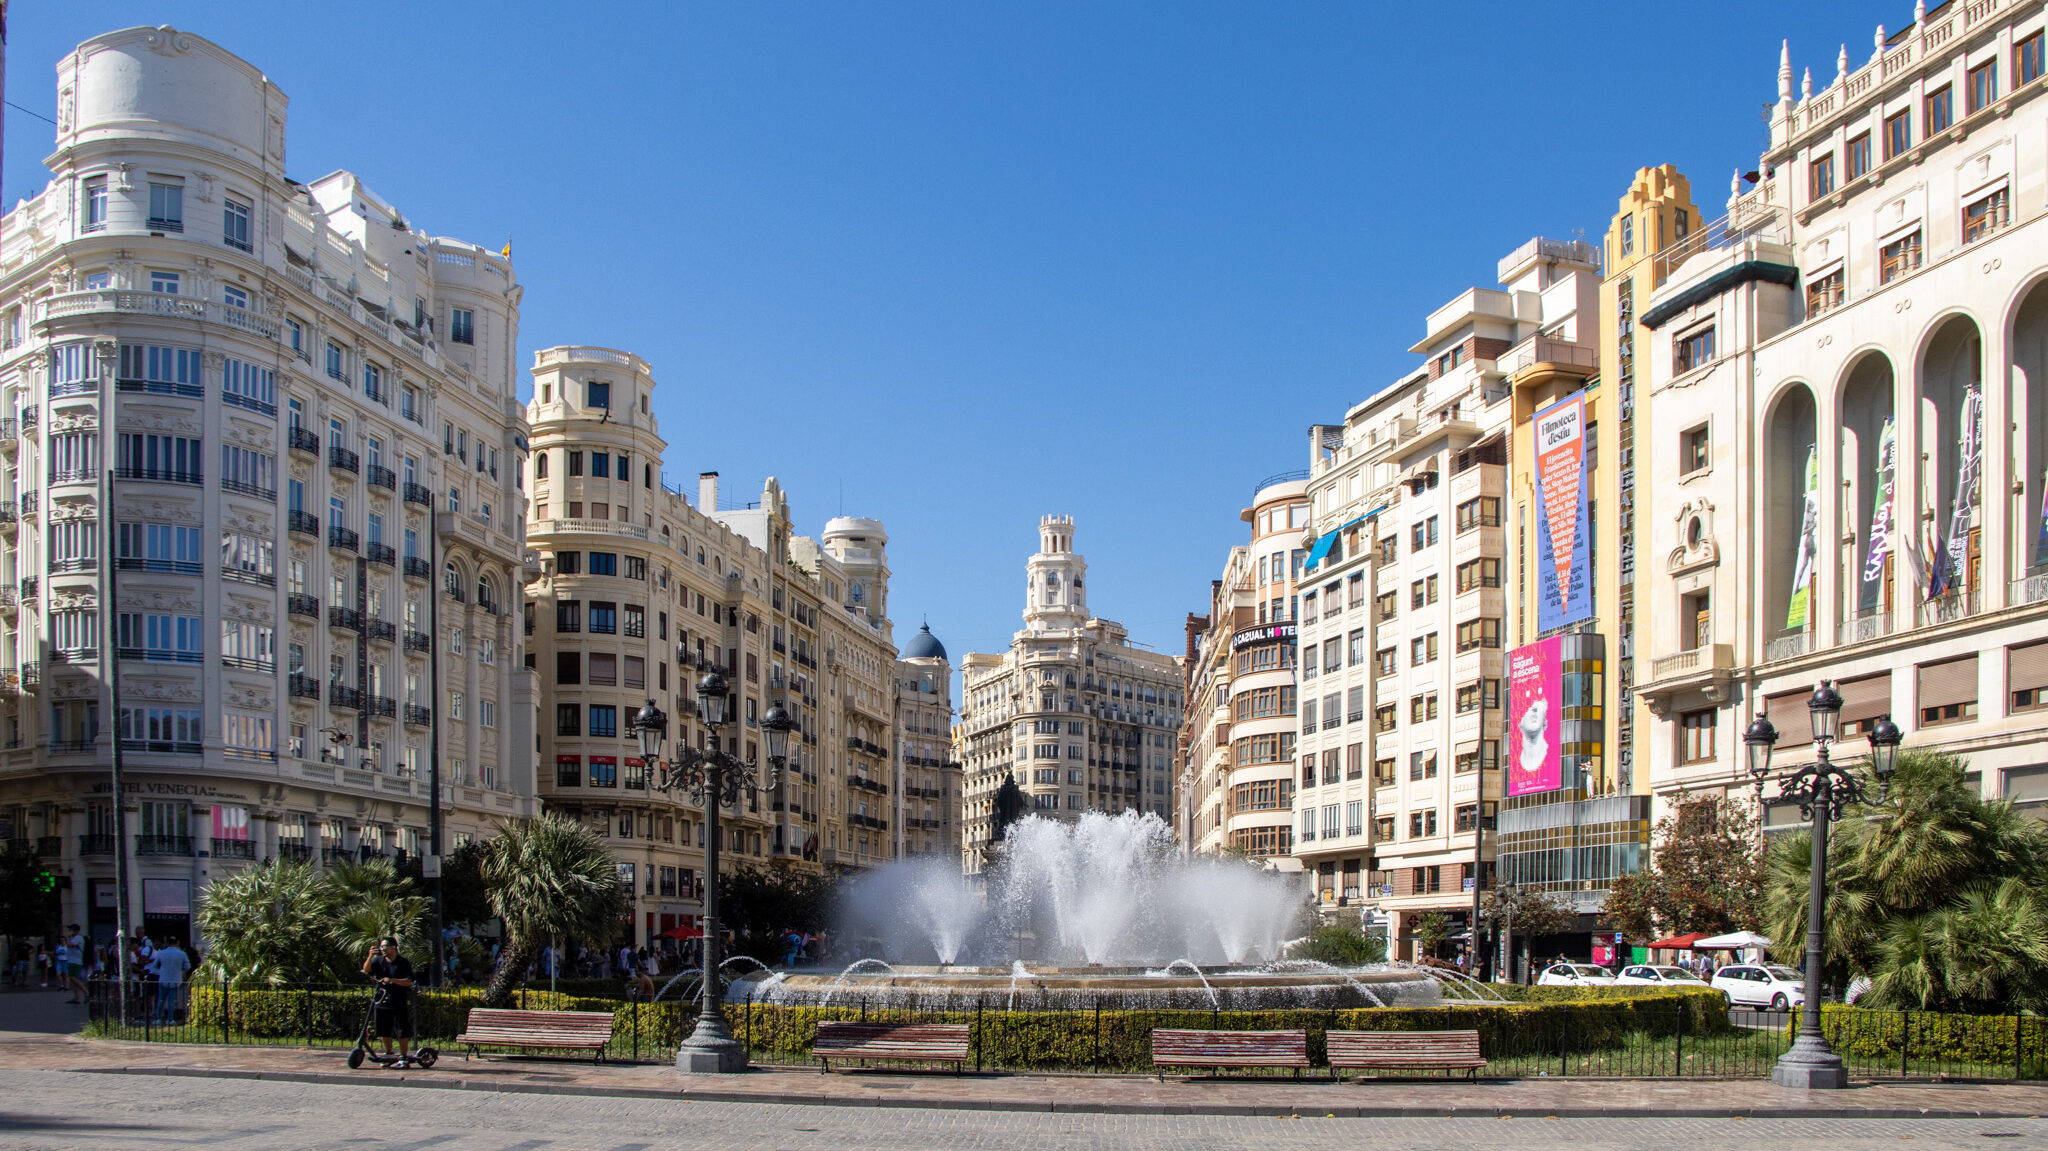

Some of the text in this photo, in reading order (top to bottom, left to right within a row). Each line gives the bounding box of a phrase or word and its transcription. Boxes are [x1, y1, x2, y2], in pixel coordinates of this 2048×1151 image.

[1618, 297, 1634, 422] RIALTO
[1541, 411, 1577, 436] Filmoteca
[1618, 448, 1634, 574] TEATRE
[1237, 629, 1265, 645] CASUAL
[1513, 655, 1534, 670] sagunt
[1513, 671, 1518, 679] a
[1518, 665, 1540, 678] escena
[1618, 598, 1634, 788] FILMOTECA
[148, 783, 208, 796] VENECIA
